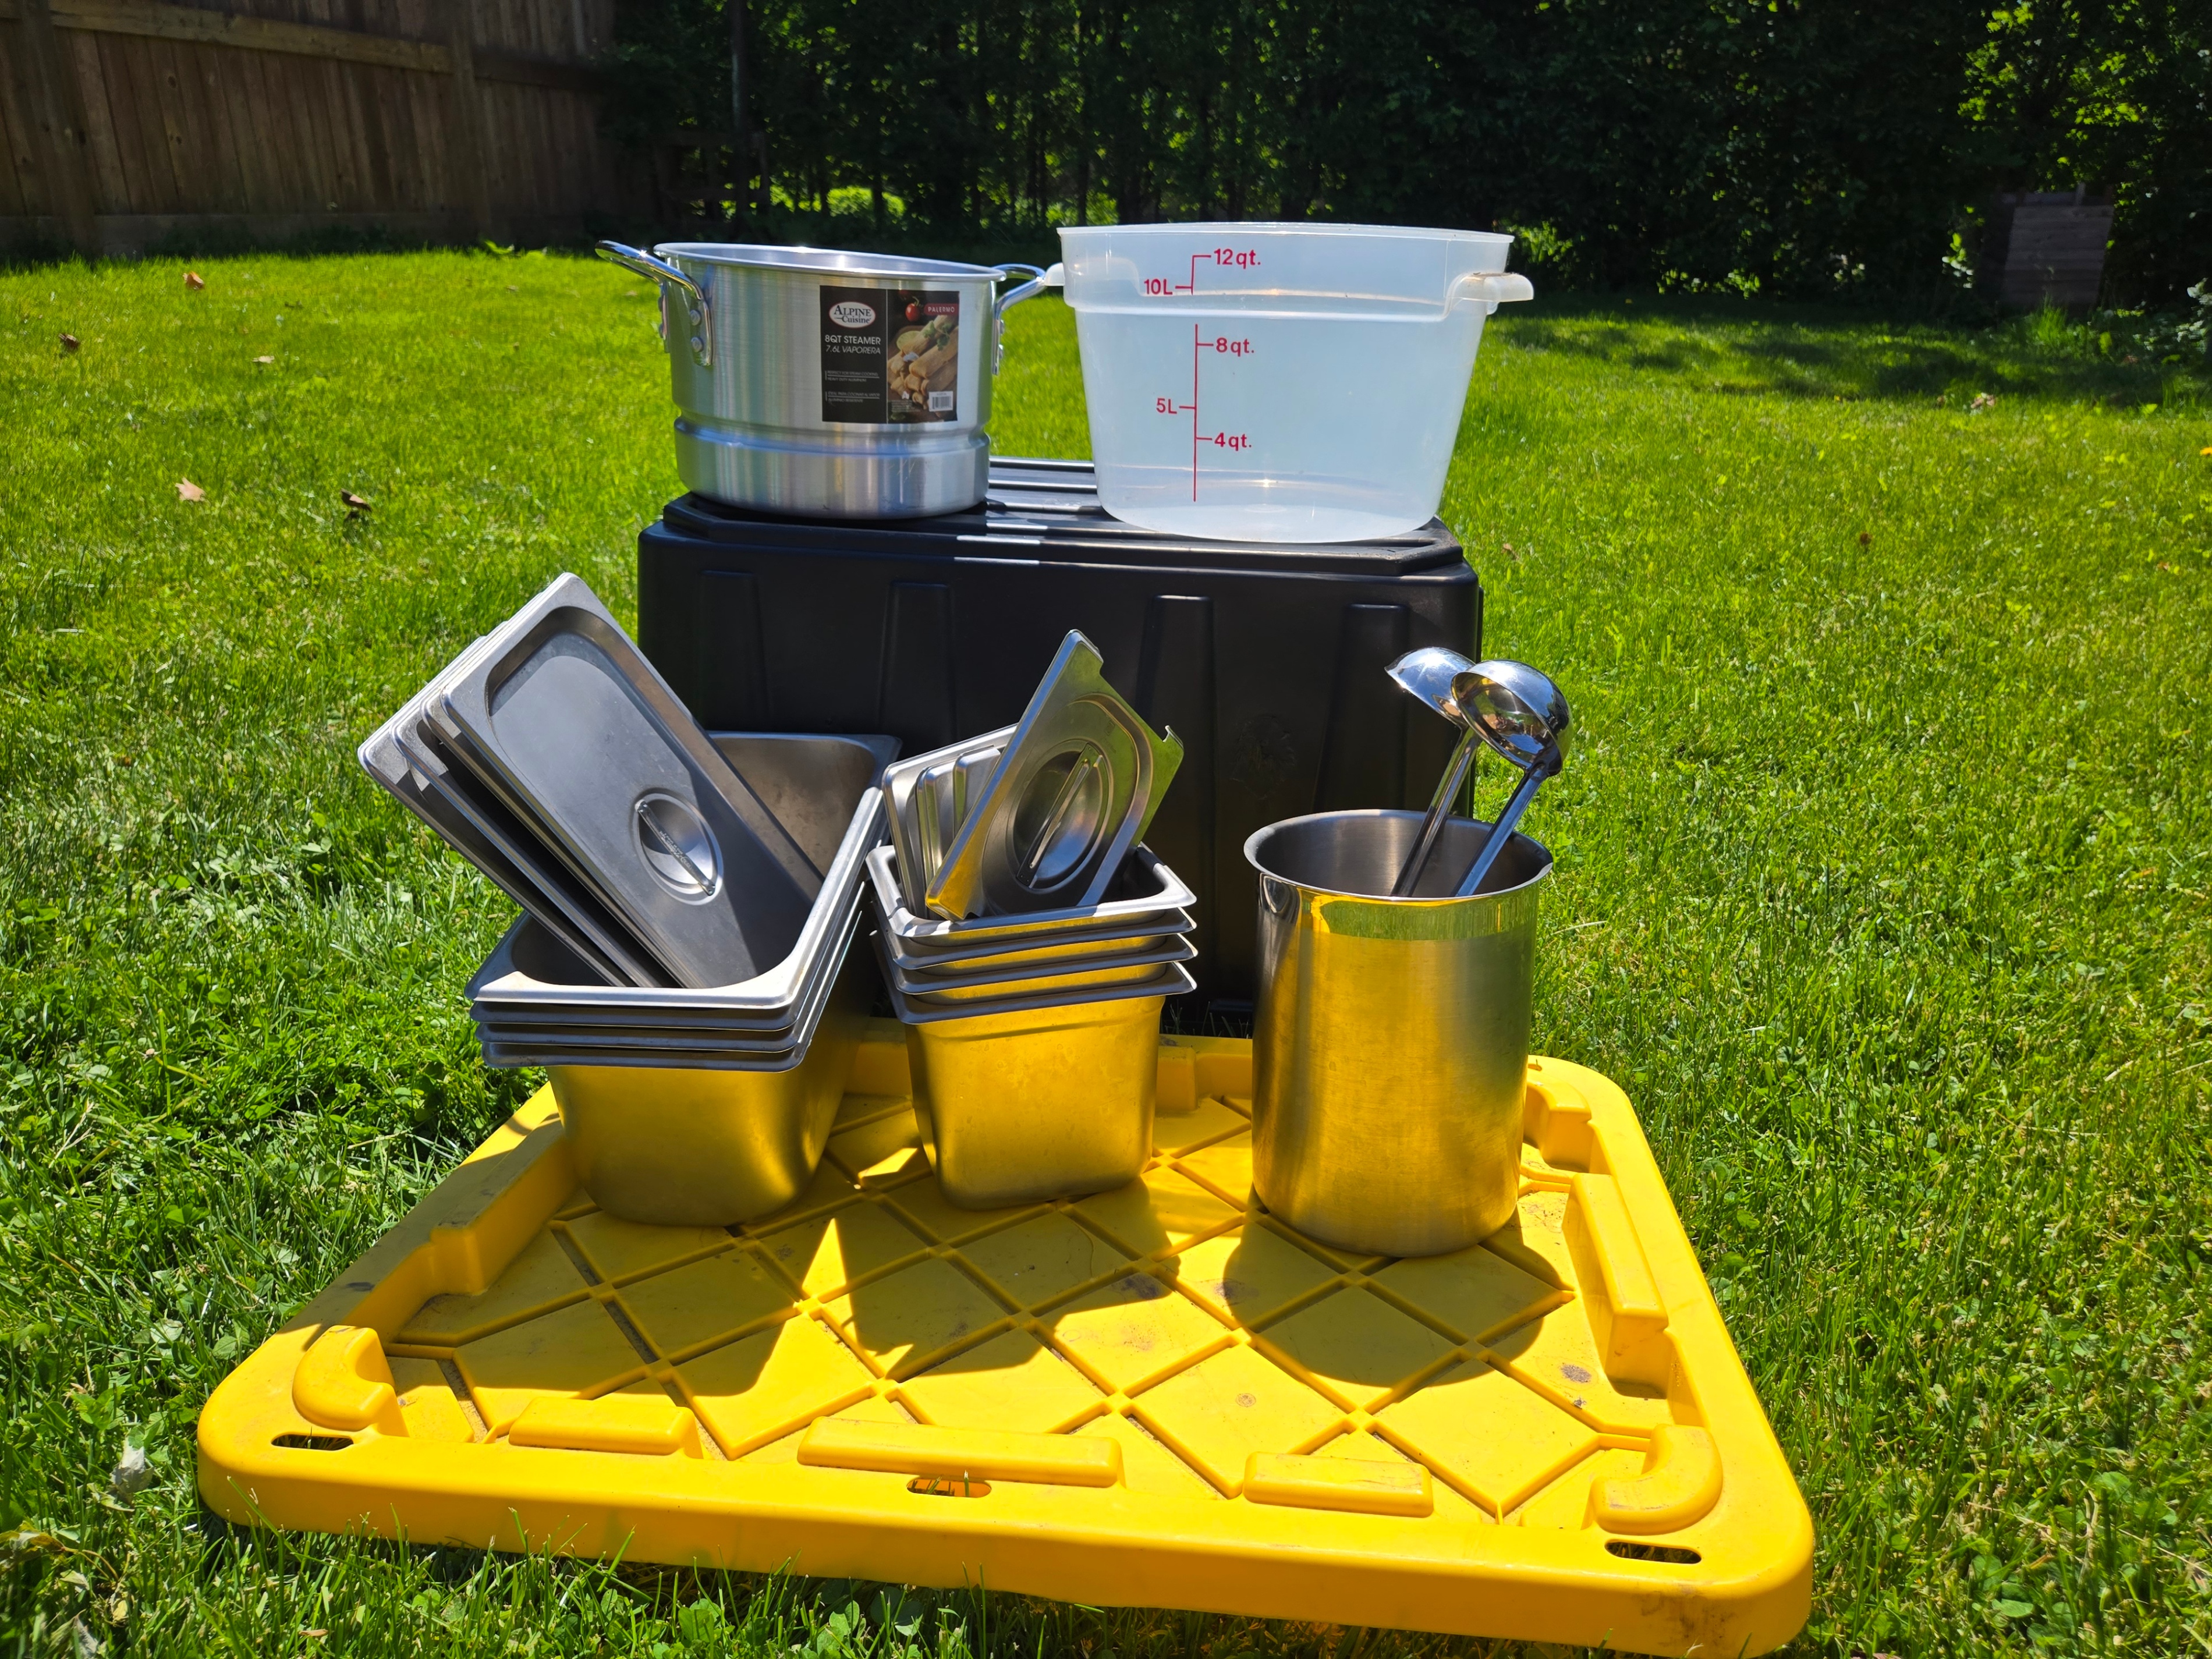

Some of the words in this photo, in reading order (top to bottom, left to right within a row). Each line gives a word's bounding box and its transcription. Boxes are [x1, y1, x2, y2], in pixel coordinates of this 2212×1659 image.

[1144, 278, 1173, 295] 10L
[834, 304, 872, 317] ALPINE
[842, 315, 870, 324] Cuisine
[825, 334, 842, 343] 8QT
[843, 335, 881, 345] STEAMER
[826, 344, 841, 353] 7.6L
[842, 345, 881, 354] VAPORERA
[1156, 398, 1178, 414] 5L
